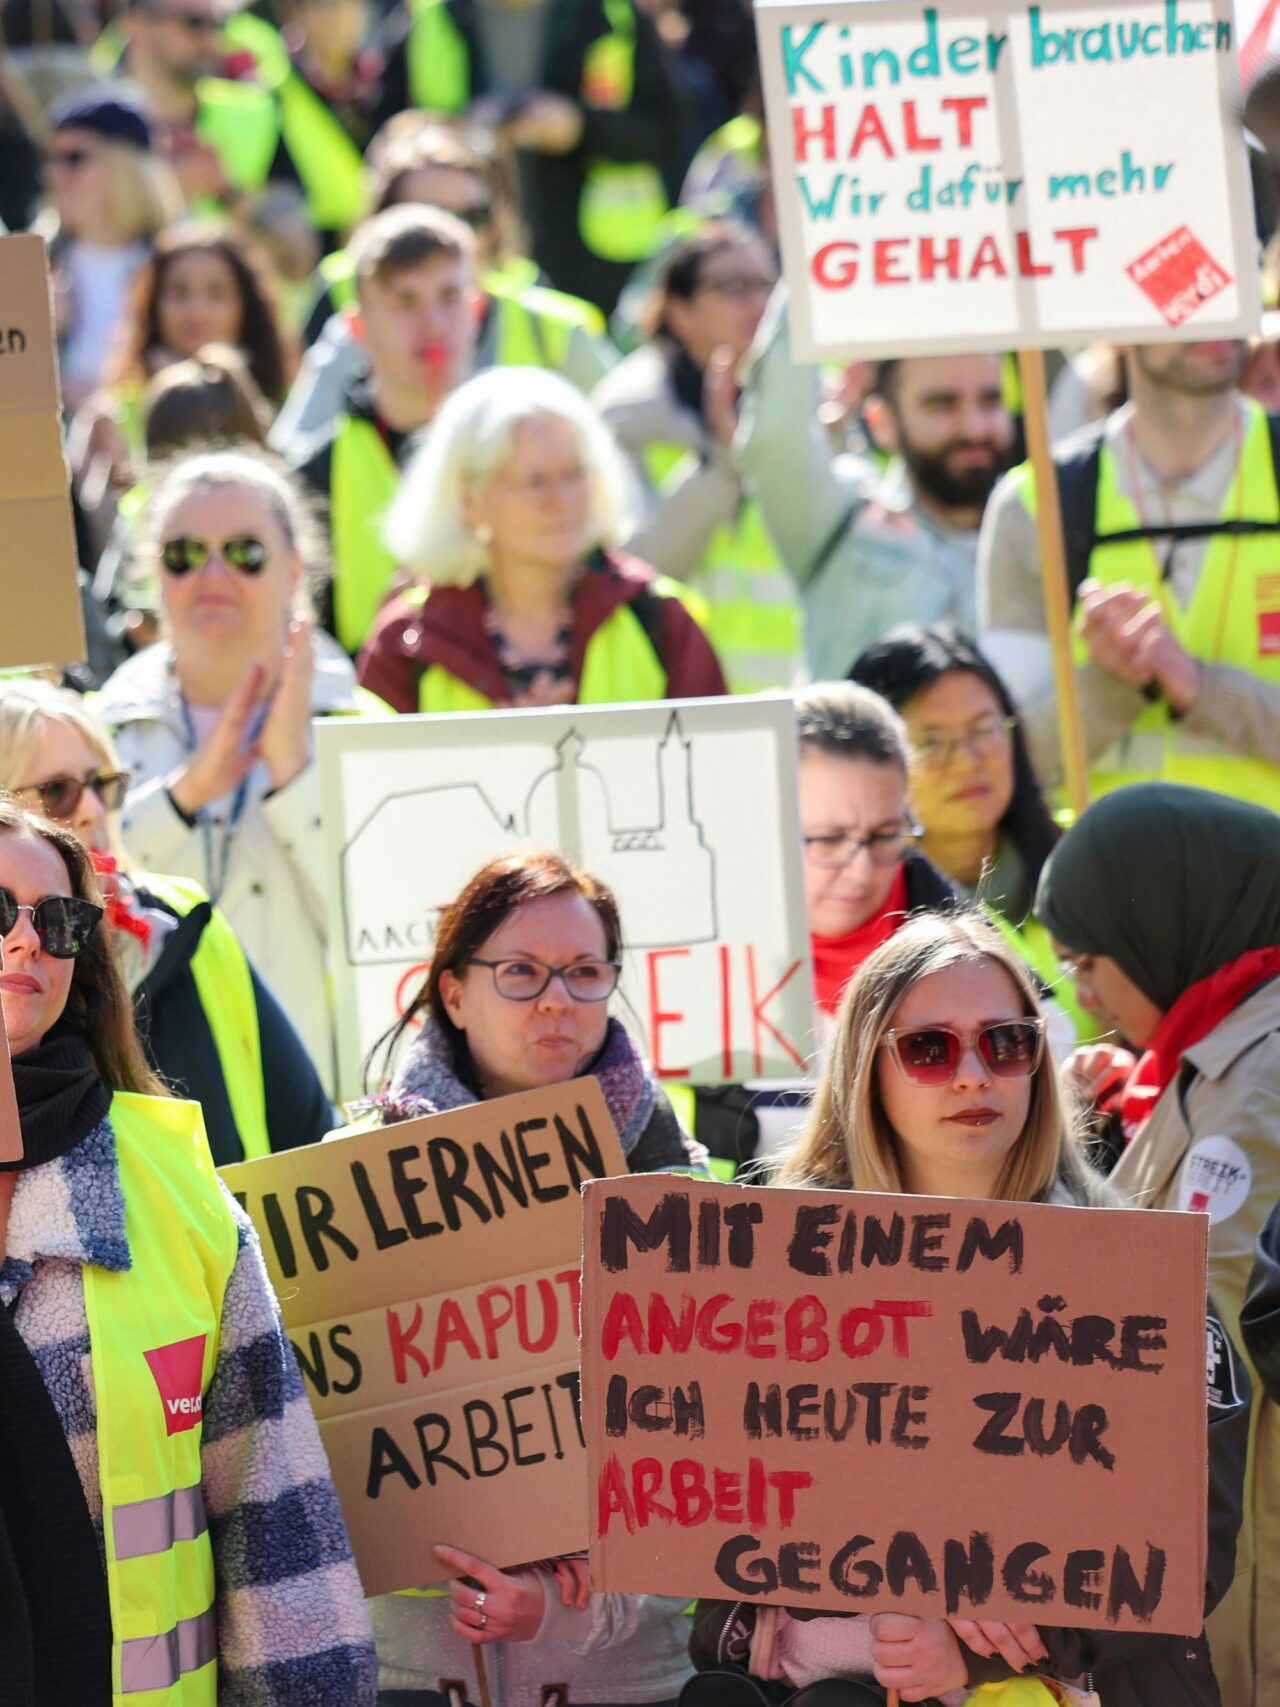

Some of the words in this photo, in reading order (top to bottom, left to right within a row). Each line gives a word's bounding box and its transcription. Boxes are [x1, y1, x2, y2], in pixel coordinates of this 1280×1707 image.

[780, 8, 1008, 95] Kinder
[1029, 0, 1232, 68] brauchen
[791, 96, 987, 163] HALT
[797, 172, 885, 222] Wir
[906, 164, 1022, 213] dafür
[1048, 150, 1175, 199] mehr
[811, 227, 1099, 291] GEHALT
[233, 1186, 359, 1279] IR
[350, 1103, 608, 1251] LERNEN
[600, 1192, 763, 1273] MIT
[786, 1204, 1024, 1277] EINEM
[289, 1324, 362, 1397] NS
[601, 1291, 933, 1363] ANGEBOT
[959, 1294, 1168, 1374] WÄRE
[604, 1373, 706, 1442] ICH
[743, 1380, 933, 1450] HEUTE
[971, 1391, 1116, 1473] ZUR
[598, 1451, 813, 1537] ARBEIT
[714, 1530, 1167, 1625] GEGANGEN
